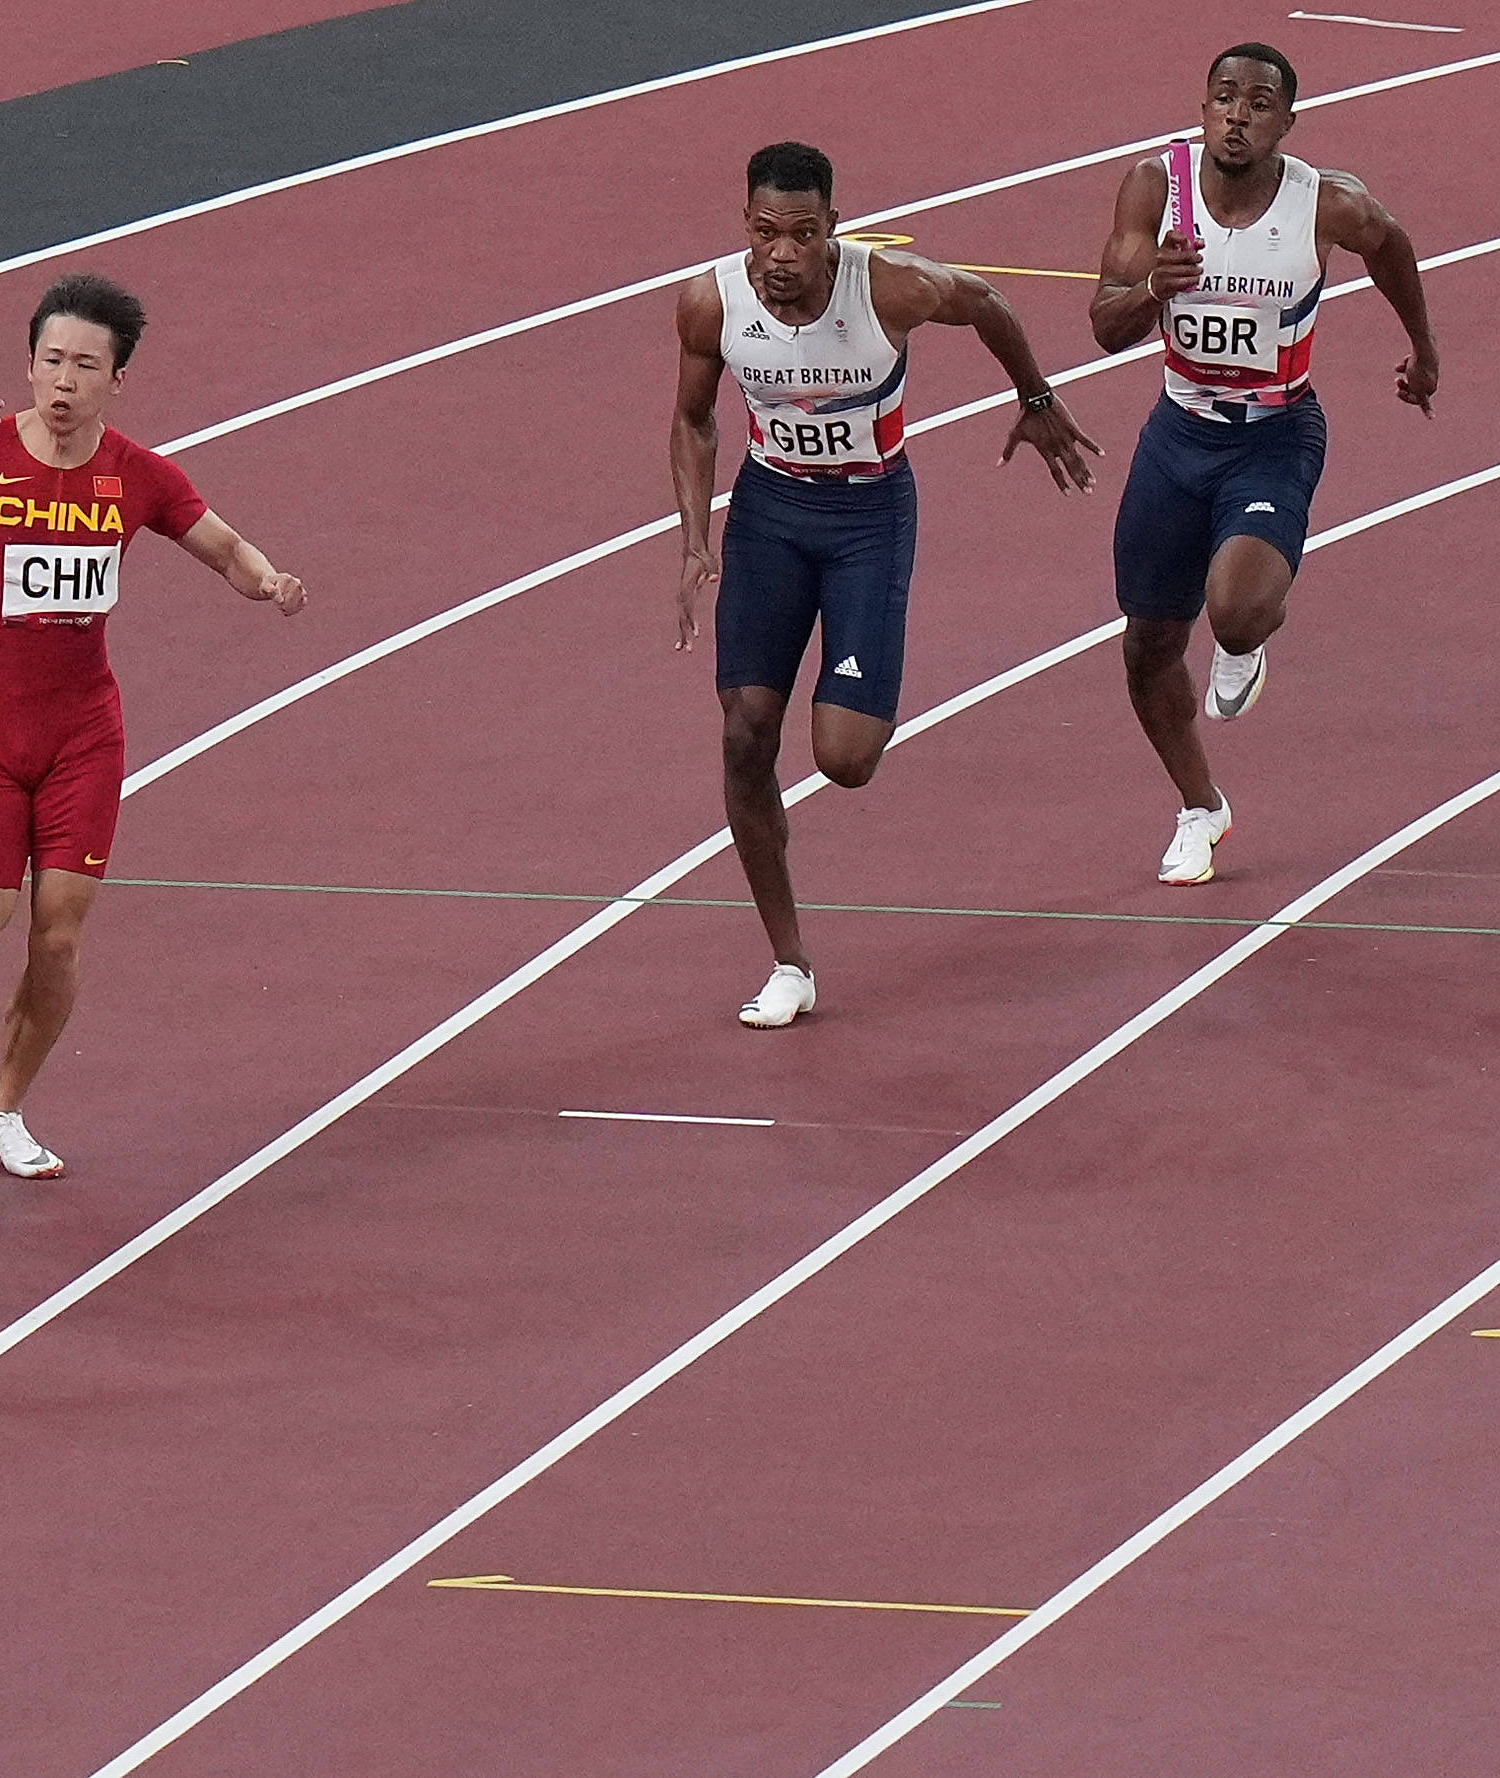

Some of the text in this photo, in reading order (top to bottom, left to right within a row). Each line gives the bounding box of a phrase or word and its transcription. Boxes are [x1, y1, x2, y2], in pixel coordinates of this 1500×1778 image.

[1227, 276, 1294, 298] BRITAIN
[1173, 313, 1258, 355] GBR
[743, 366, 873, 384] GREAT BRITAIN
[769, 418, 854, 456] GBR
[21, 556, 111, 600] CHN
